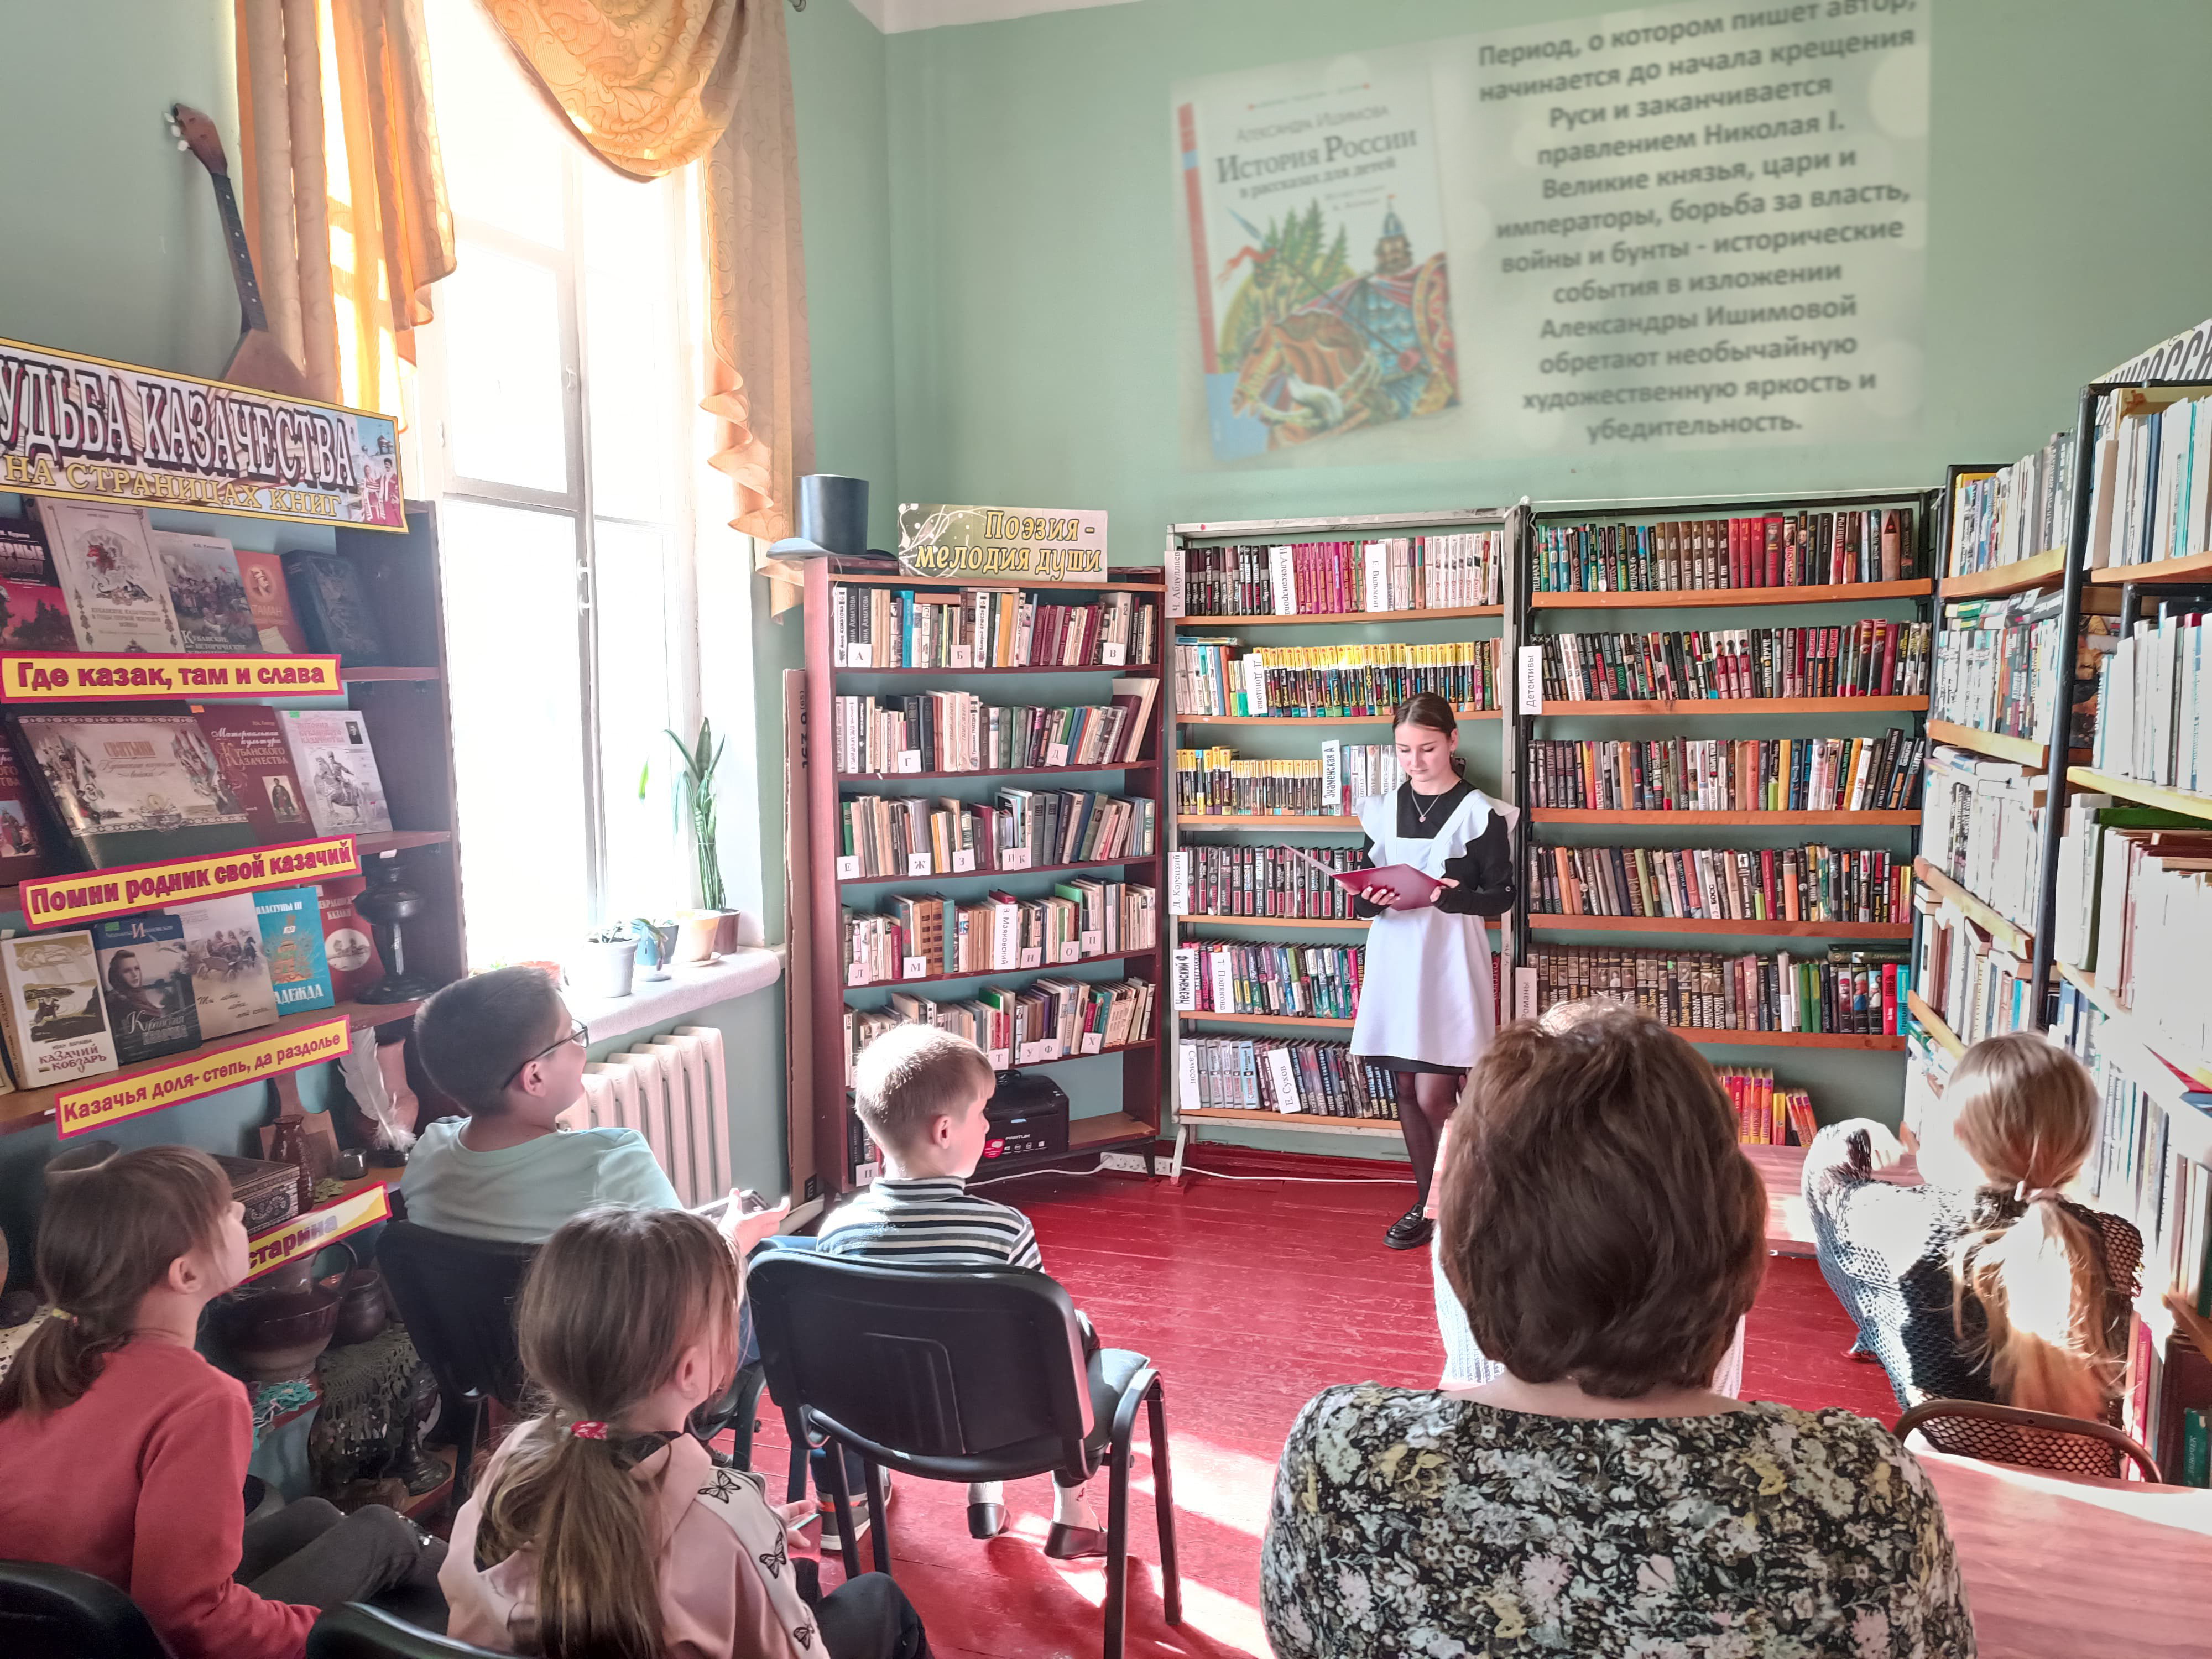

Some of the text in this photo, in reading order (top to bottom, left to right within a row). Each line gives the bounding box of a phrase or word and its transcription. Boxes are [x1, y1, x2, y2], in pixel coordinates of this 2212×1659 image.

[1479, 0, 1917, 68] Период, о котором пишет автор,
[1479, 29, 1916, 103] начинается до начала крещения
[1549, 76, 1833, 132] Руси и заканчивается
[1537, 131, 1697, 169] правлением
[1704, 114, 1820, 147] Николая
[1250, 173, 1321, 199] рассказах
[1323, 168, 1350, 184] для
[1353, 155, 1397, 177] детей
[1542, 149, 1856, 200] Великие князья, цари и
[1496, 181, 1911, 239] императоры, борьба за власть,
[1501, 247, 1582, 273] войны
[1589, 249, 1604, 265] и
[1611, 239, 1690, 268] бунты
[1713, 220, 1905, 256] исторические
[1553, 263, 1843, 305] события в изложении
[1540, 294, 1858, 340] Александры Ишимовой
[1539, 336, 1858, 377] обретают необычайную
[1522, 372, 1876, 413] художественную яркость и
[136, 382, 359, 494] КАЗАЧЕСТВА
[1586, 413, 1803, 444] убедительность.
[4, 455, 342, 517] НА СТРАНИЦАХ КНИГ
[984, 510, 1079, 541] Поэзия
[915, 545, 1102, 582] мелодия души
[1172, 552, 1182, 599] Абдуллаев
[856, 651, 863, 661] А
[957, 651, 963, 660] Б
[1110, 649, 1116, 658] В
[18, 662, 325, 691] Где казак, там и слава
[1254, 673, 1264, 709] Донцова
[1526, 655, 1537, 707] Детективы
[905, 758, 911, 767] Г
[1051, 749, 1061, 758] Д
[1324, 754, 1336, 798] Знаменская
[844, 863, 851, 872] Е
[914, 860, 926, 869] Ж
[959, 858, 966, 866] З
[1019, 854, 1026, 863] К
[31, 841, 352, 914] Помни родник свой казачий
[1172, 855, 1182, 900] Корецкий
[1001, 917, 1011, 965] Маяковский
[1027, 954, 1035, 963] Н
[1066, 947, 1072, 956] О
[1089, 936, 1096, 945] П
[855, 970, 863, 978] Л
[911, 963, 921, 972] М
[1175, 963, 1190, 1004] Незнанский
[1521, 982, 1530, 1019] Романы
[39, 1044, 100, 1065] КАЗАЧИЙ
[996, 1054, 1003, 1062] Т
[1027, 1048, 1034, 1057] У
[1044, 1045, 1052, 1053] Ф
[1088, 1037, 1095, 1046] Х
[52, 1054, 107, 1073] КОБЗАРЬ
[64, 1034, 341, 1123] Казачья доля- степь, да раздолье
[1281, 1066, 1293, 1094] Сухов
[249, 1215, 338, 1270] старина
